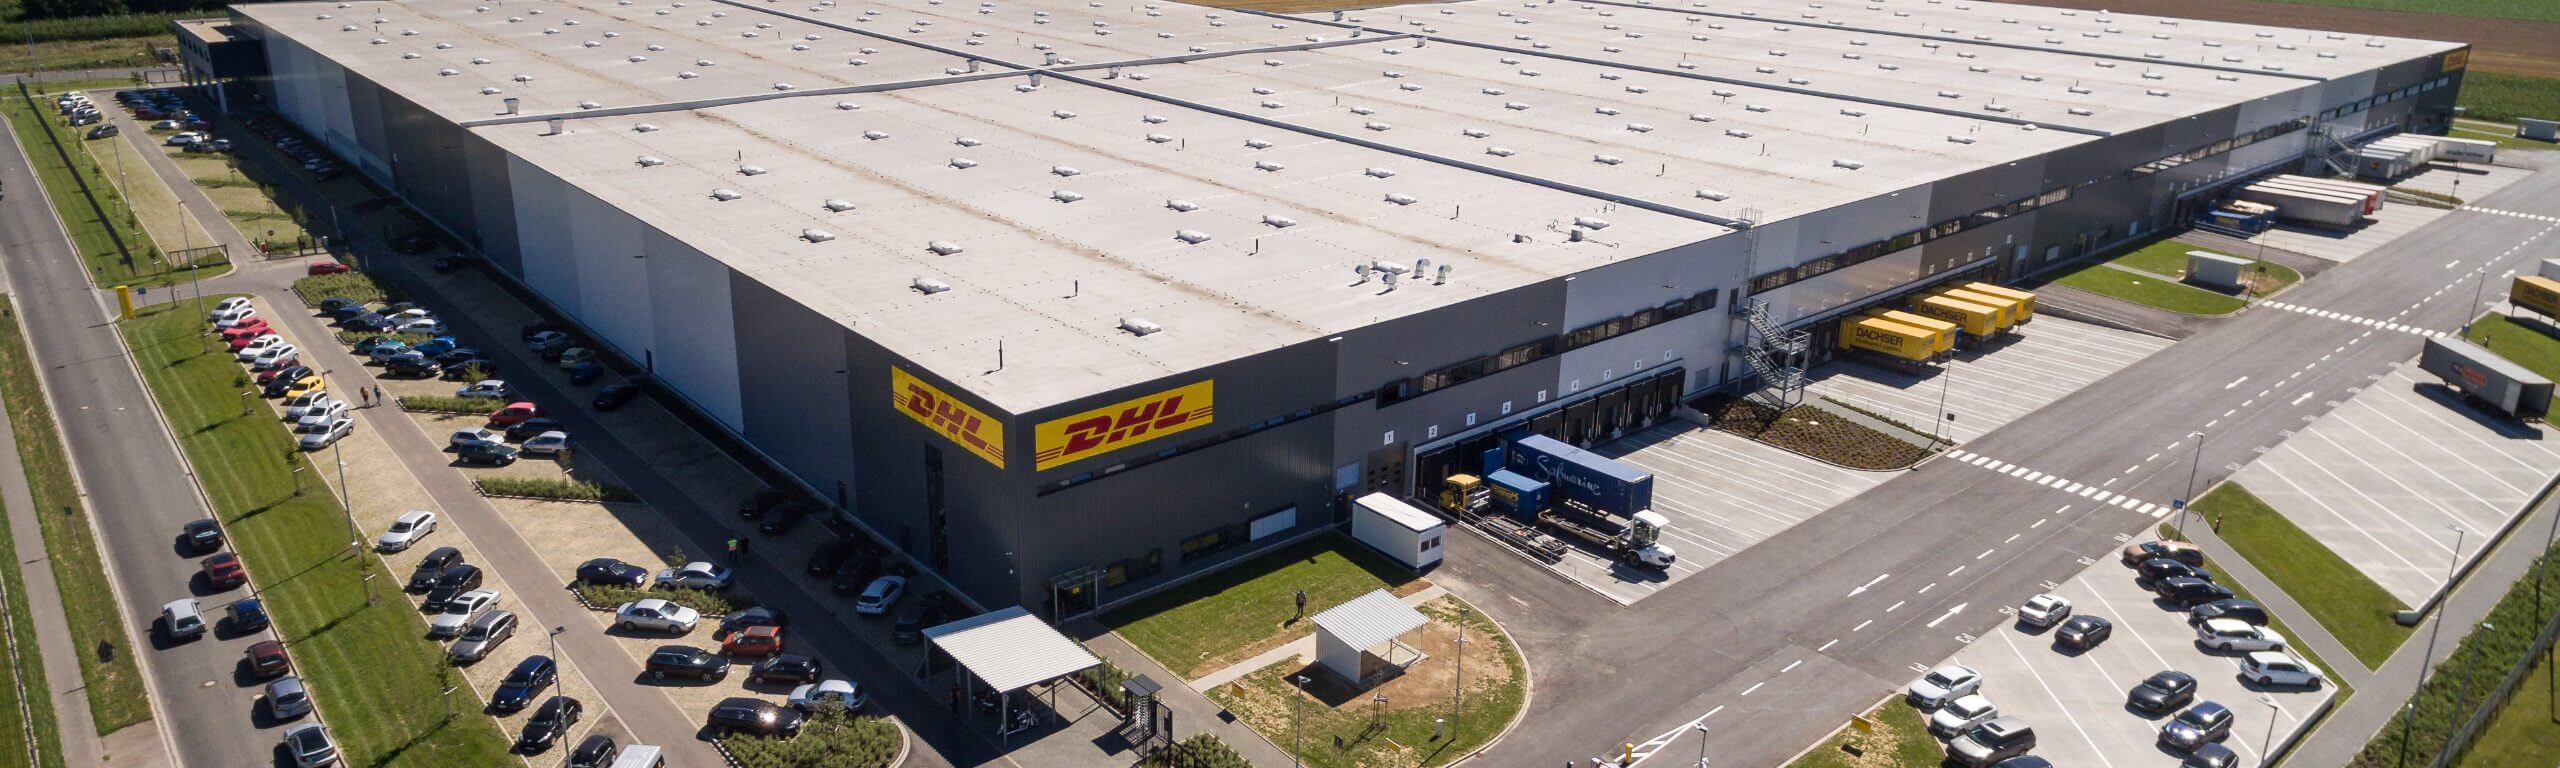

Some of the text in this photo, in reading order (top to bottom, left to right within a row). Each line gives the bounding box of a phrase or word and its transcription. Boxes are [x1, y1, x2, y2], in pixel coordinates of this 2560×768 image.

[1921, 303, 1967, 323] DACHSER
[1856, 327, 1903, 347] DACHSER
[907, 382, 988, 451] DHL
[1062, 394, 1192, 457] DHL
[1535, 455, 1601, 496] Safmarine
[1907, 662, 1929, 673] P1
